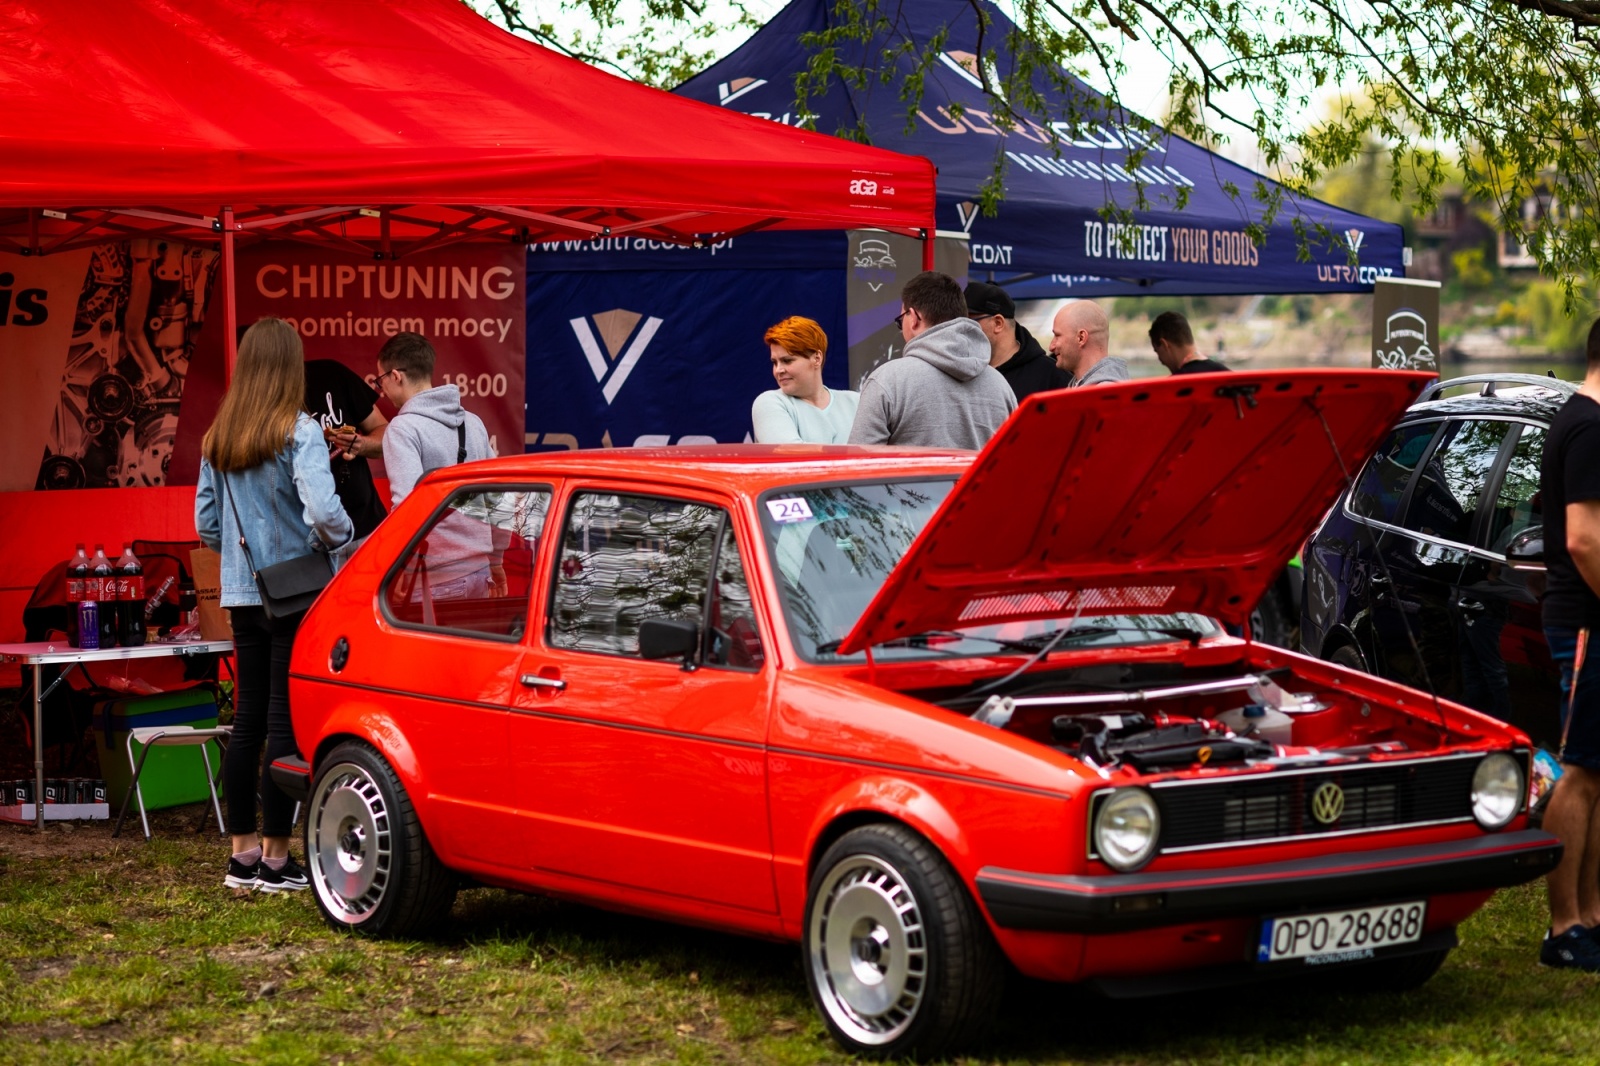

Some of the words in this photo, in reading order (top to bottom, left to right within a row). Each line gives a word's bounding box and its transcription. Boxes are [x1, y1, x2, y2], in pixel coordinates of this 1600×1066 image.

[968, 244, 1013, 265] COAT
[1084, 221, 1103, 257] TO
[1106, 222, 1169, 262] PROTECT
[1171, 227, 1209, 264] YOUR
[1212, 230, 1259, 267] GOODS
[256, 264, 516, 300] CHIPTUNING
[434, 317, 513, 343] mocy
[775, 502, 804, 518] 24
[1274, 917, 1330, 956] OPO
[1336, 905, 1422, 949] 28688
